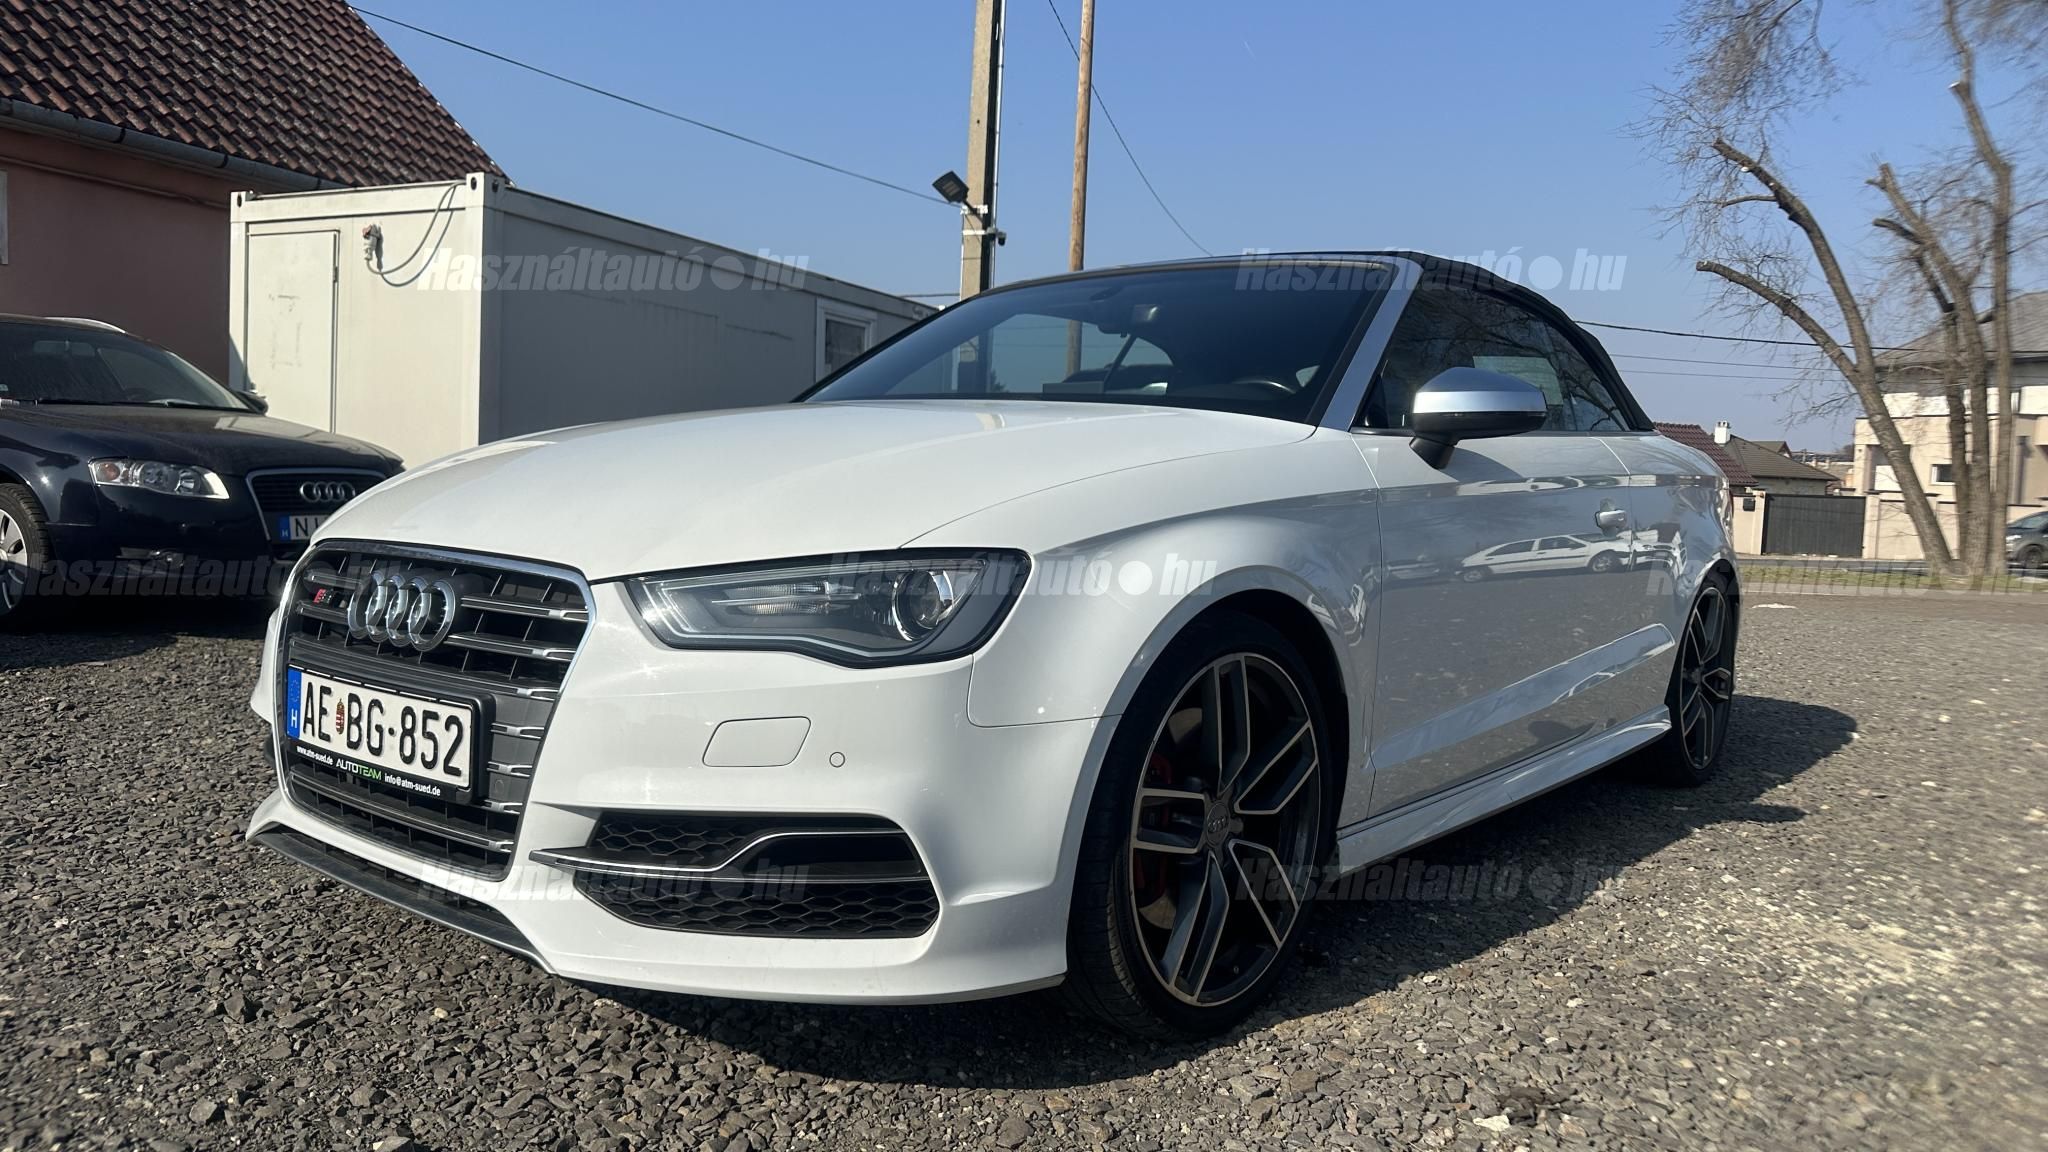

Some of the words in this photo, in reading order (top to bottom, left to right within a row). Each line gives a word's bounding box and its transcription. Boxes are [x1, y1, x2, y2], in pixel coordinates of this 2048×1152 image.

[290, 708, 298, 729] H
[303, 681, 333, 742] AE
[336, 758, 382, 781] AUTOTEAM
[384, 773, 441, 796] info@atm-sued.de
